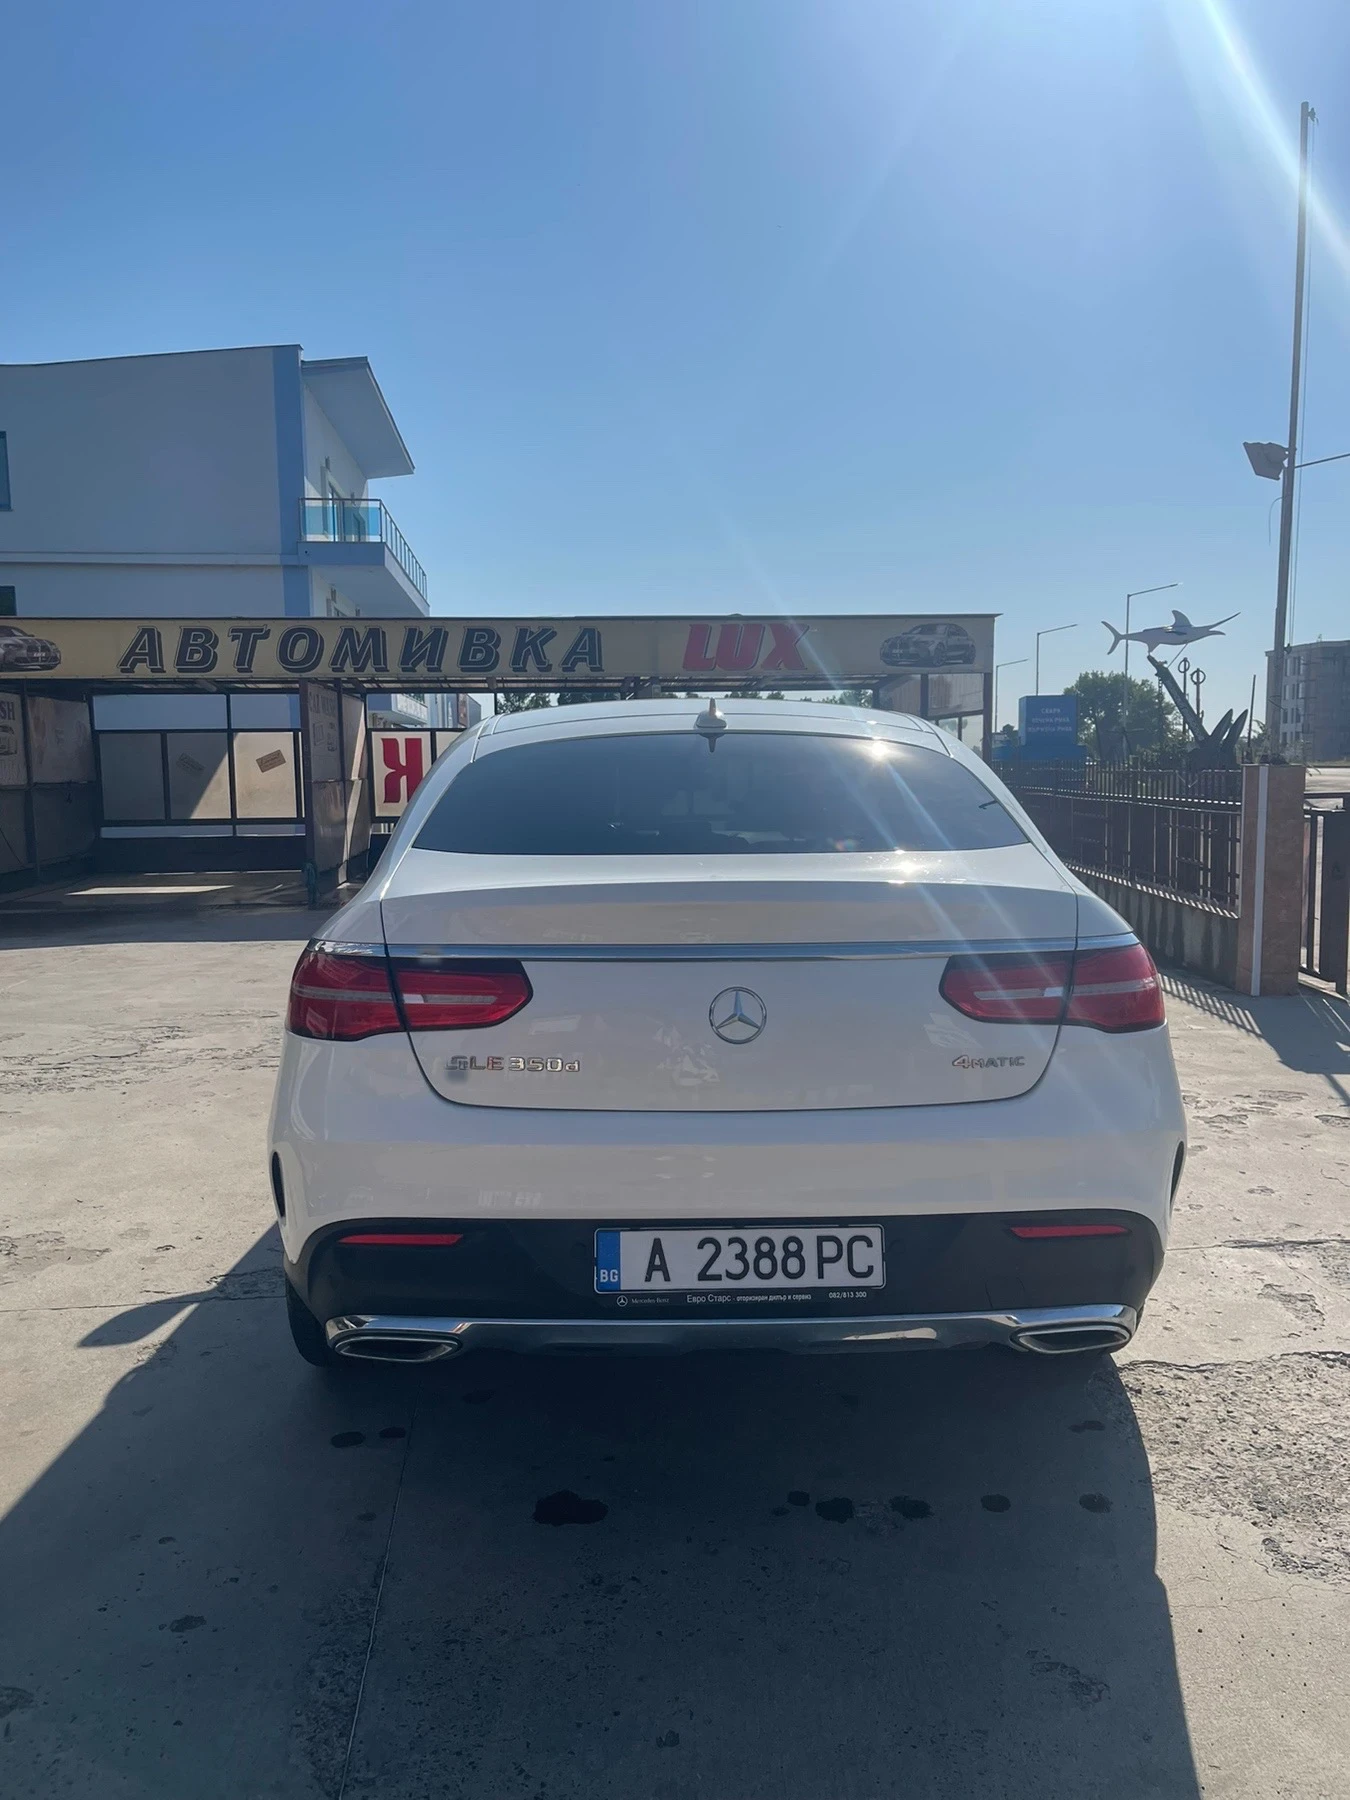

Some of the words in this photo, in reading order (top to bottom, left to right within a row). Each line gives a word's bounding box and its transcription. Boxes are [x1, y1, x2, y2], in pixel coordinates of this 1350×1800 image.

[118, 625, 605, 673] АВТОМИВКА
[682, 623, 810, 671] LUX
[952, 1054, 1025, 1069] 4MATIC
[600, 1269, 618, 1283] BG
[686, 1294, 706, 1304] Евро
[707, 1293, 731, 1304] Старс
[828, 1291, 854, 1299] 082/813
